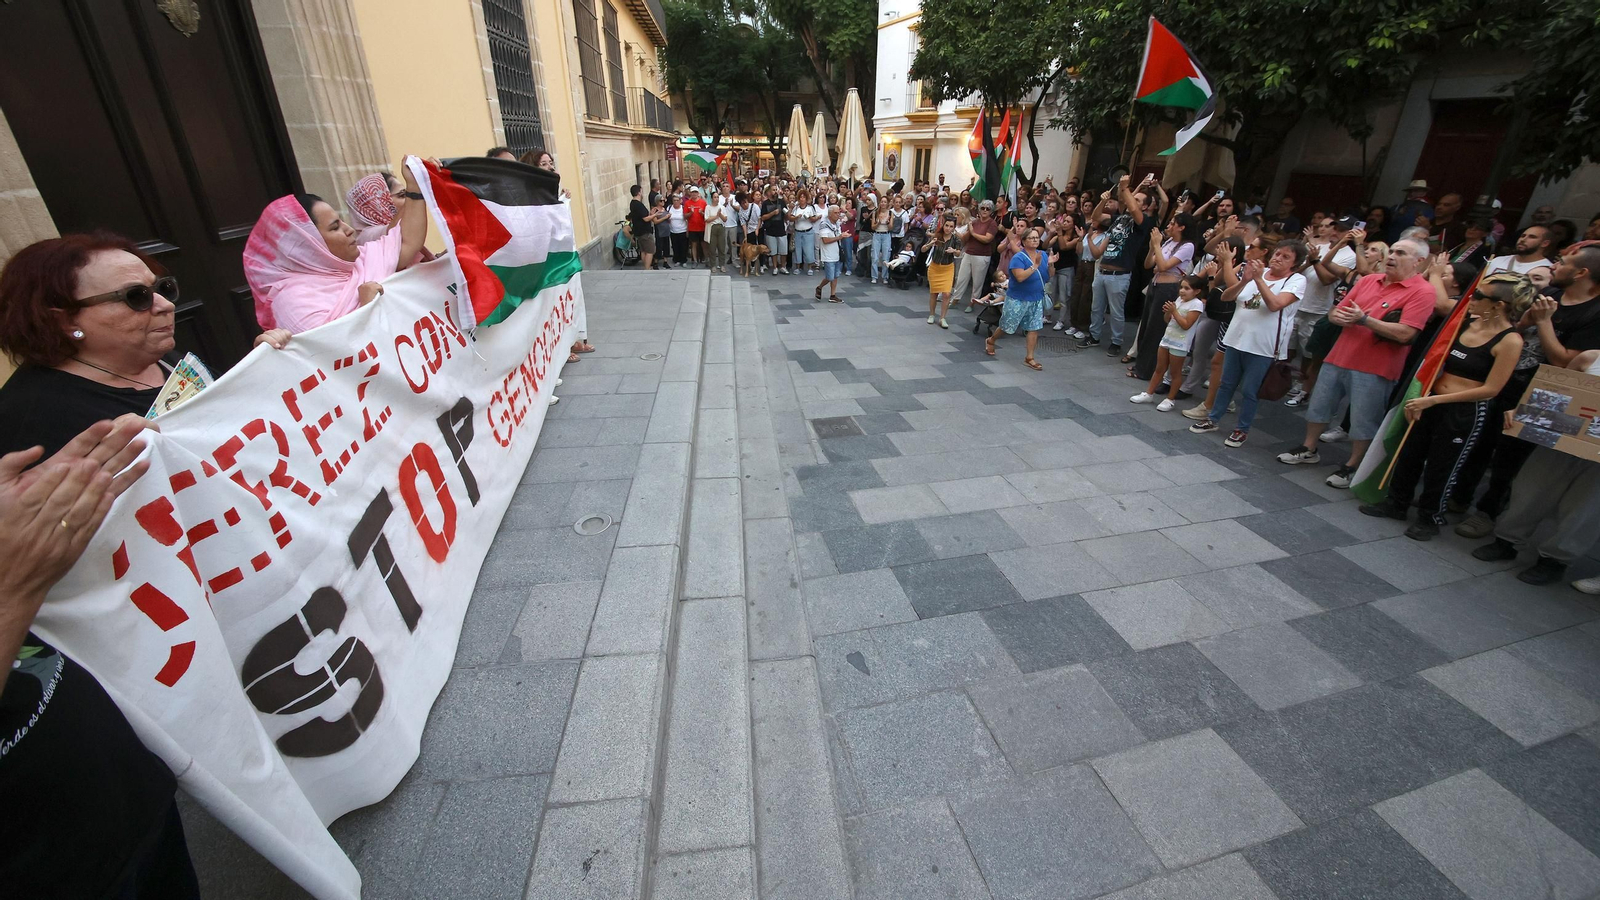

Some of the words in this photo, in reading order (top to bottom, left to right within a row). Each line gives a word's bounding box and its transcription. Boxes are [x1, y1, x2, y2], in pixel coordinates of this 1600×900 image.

[112, 342, 392, 687] JEREZ
[395, 300, 467, 394] CON
[241, 396, 480, 757] STOP
